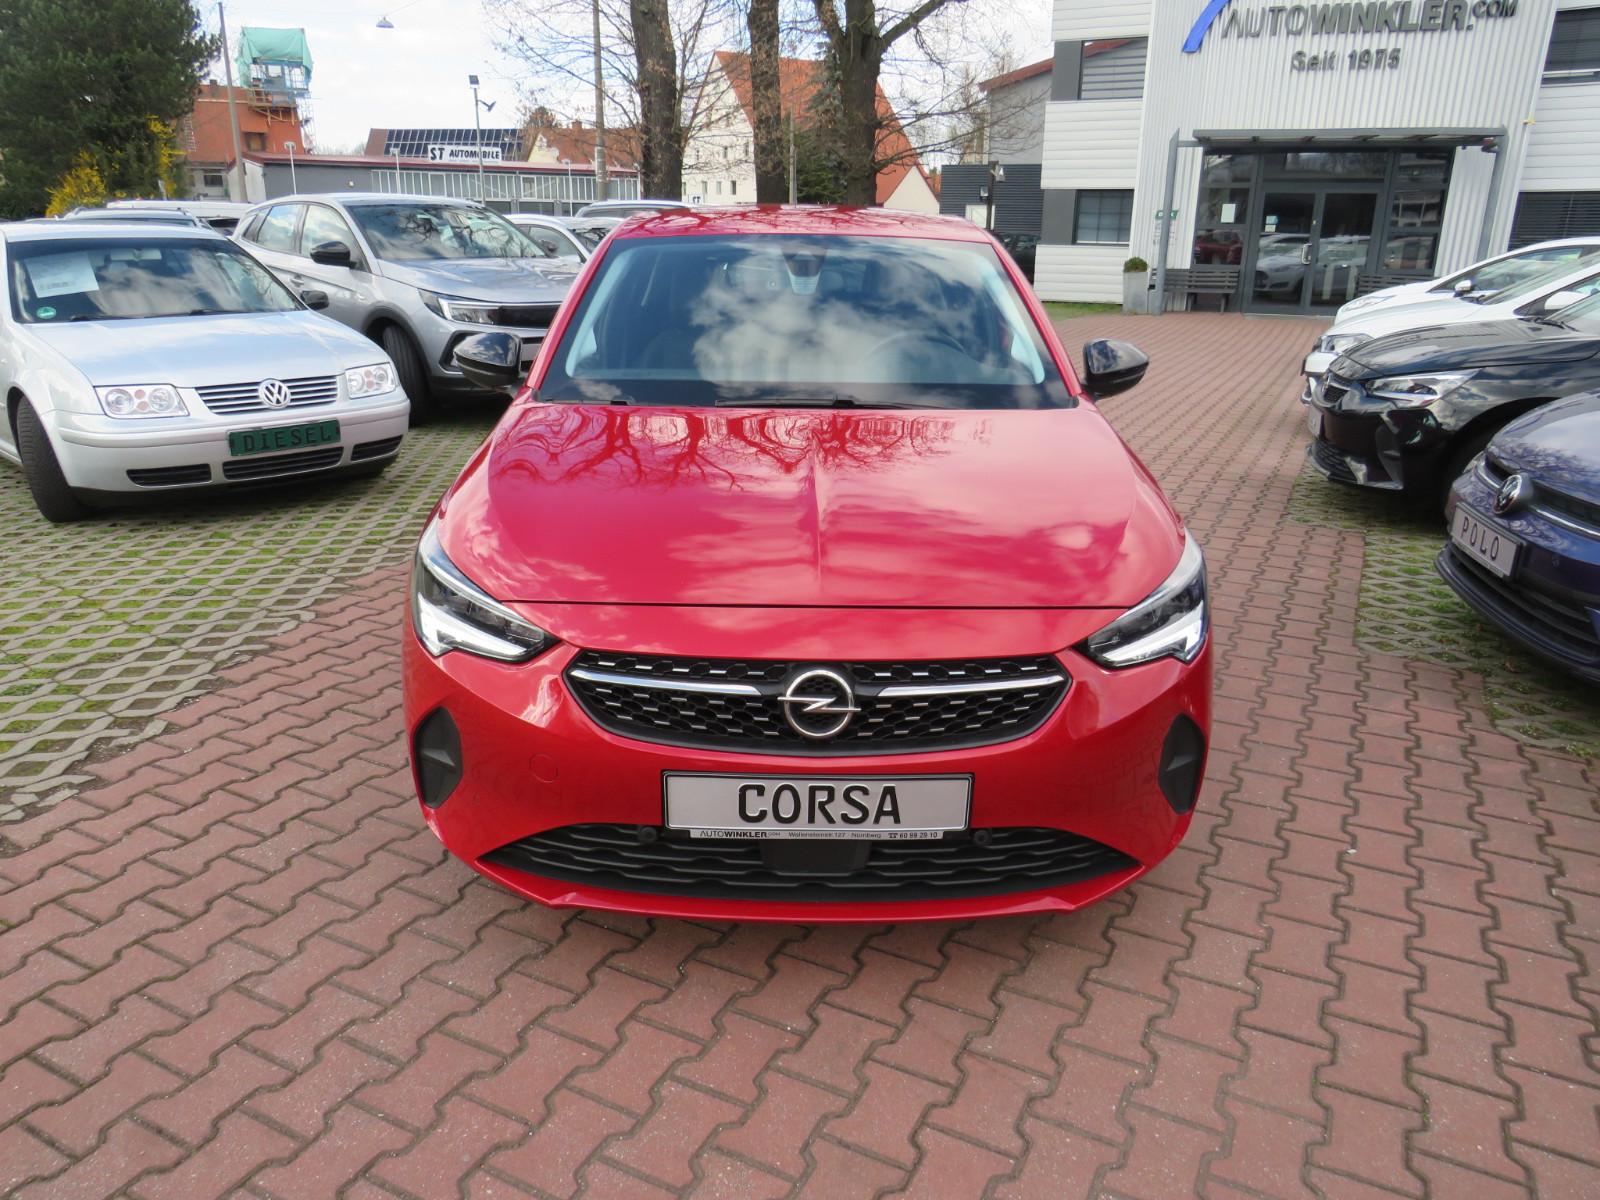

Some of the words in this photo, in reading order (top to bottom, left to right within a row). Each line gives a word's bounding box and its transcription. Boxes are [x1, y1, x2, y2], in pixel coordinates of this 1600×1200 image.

[1291, 50, 1337, 71] Seit
[1348, 48, 1402, 70] 1975
[430, 147, 445, 160] ST
[243, 424, 331, 452] DIESEL
[1461, 516, 1499, 561] POLO
[738, 784, 901, 825] CORSA
